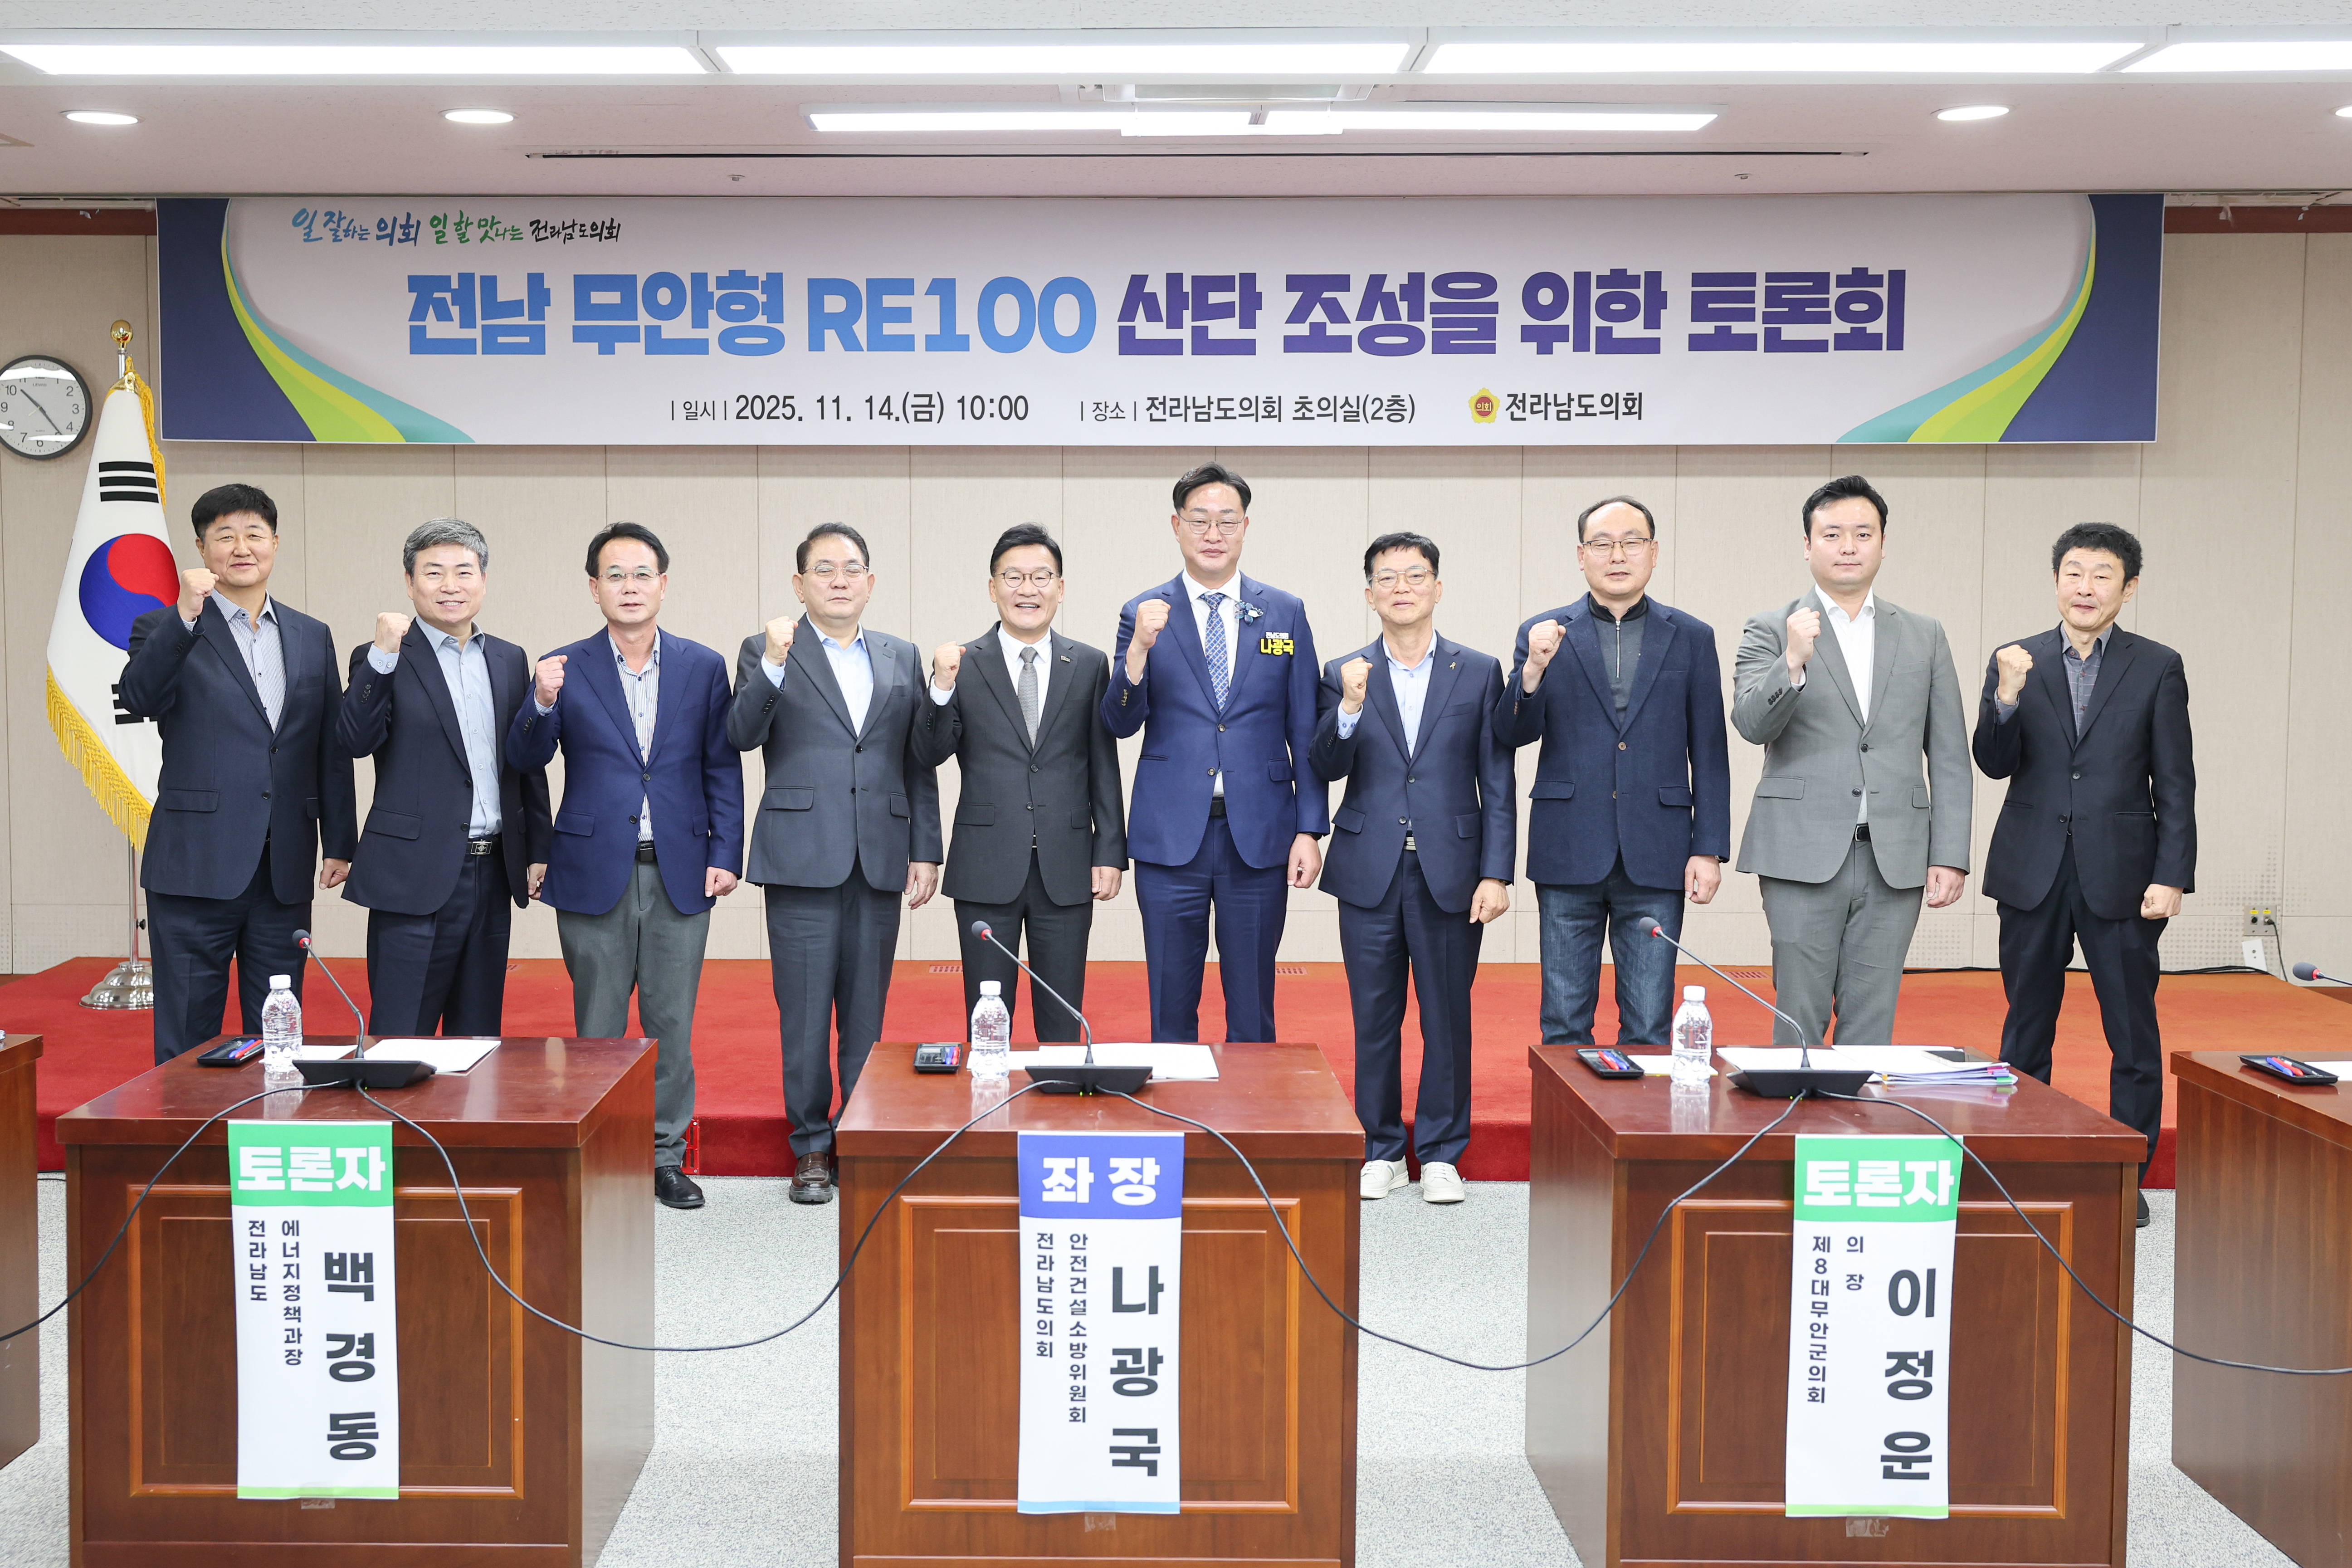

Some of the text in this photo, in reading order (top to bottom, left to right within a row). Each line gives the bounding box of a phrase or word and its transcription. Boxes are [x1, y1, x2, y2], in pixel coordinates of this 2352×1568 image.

[292, 208, 621, 247] 일 잘하는 의회 일 할 맛나는 전라남도의회
[407, 267, 1906, 357] 전남 무안형 RE100 산단 조성을 위한 토론회
[1, 402, 8, 413] 9
[5, 385, 17, 396] 10
[66, 386, 73, 396] 2
[72, 404, 79, 415] 3
[736, 395, 803, 422] 2025.
[816, 395, 852, 422] 11.
[865, 391, 944, 424] 14.(금)
[957, 395, 1029, 421] 10:00
[1146, 395, 1282, 423] 전라남도의회
[1292, 394, 1415, 424] 초의실(2층)
[1476, 402, 1492, 411] 의회
[1505, 392, 1642, 421] 전라남도의회
[20, 432, 28, 443] 7
[66, 421, 73, 431] 4
[1260, 638, 1294, 656] 나광국
[238, 1146, 386, 1192] 토론자
[1042, 1157, 1160, 1206] 좌장
[1803, 1160, 1955, 1207] 토론자
[248, 1220, 268, 1301] 전라남도
[1845, 1236, 1864, 1291] 의장
[281, 1220, 303, 1366] 에너지정책과장
[1036, 1232, 1055, 1358] 전라남도의회
[1069, 1233, 1088, 1423] 안전건설소방위원회
[1807, 1236, 1831, 1404] 제8대무안군의회
[324, 1252, 379, 1461] 백경동
[1109, 1265, 1164, 1477] 나광국
[1880, 1268, 1936, 1480] 이정운
